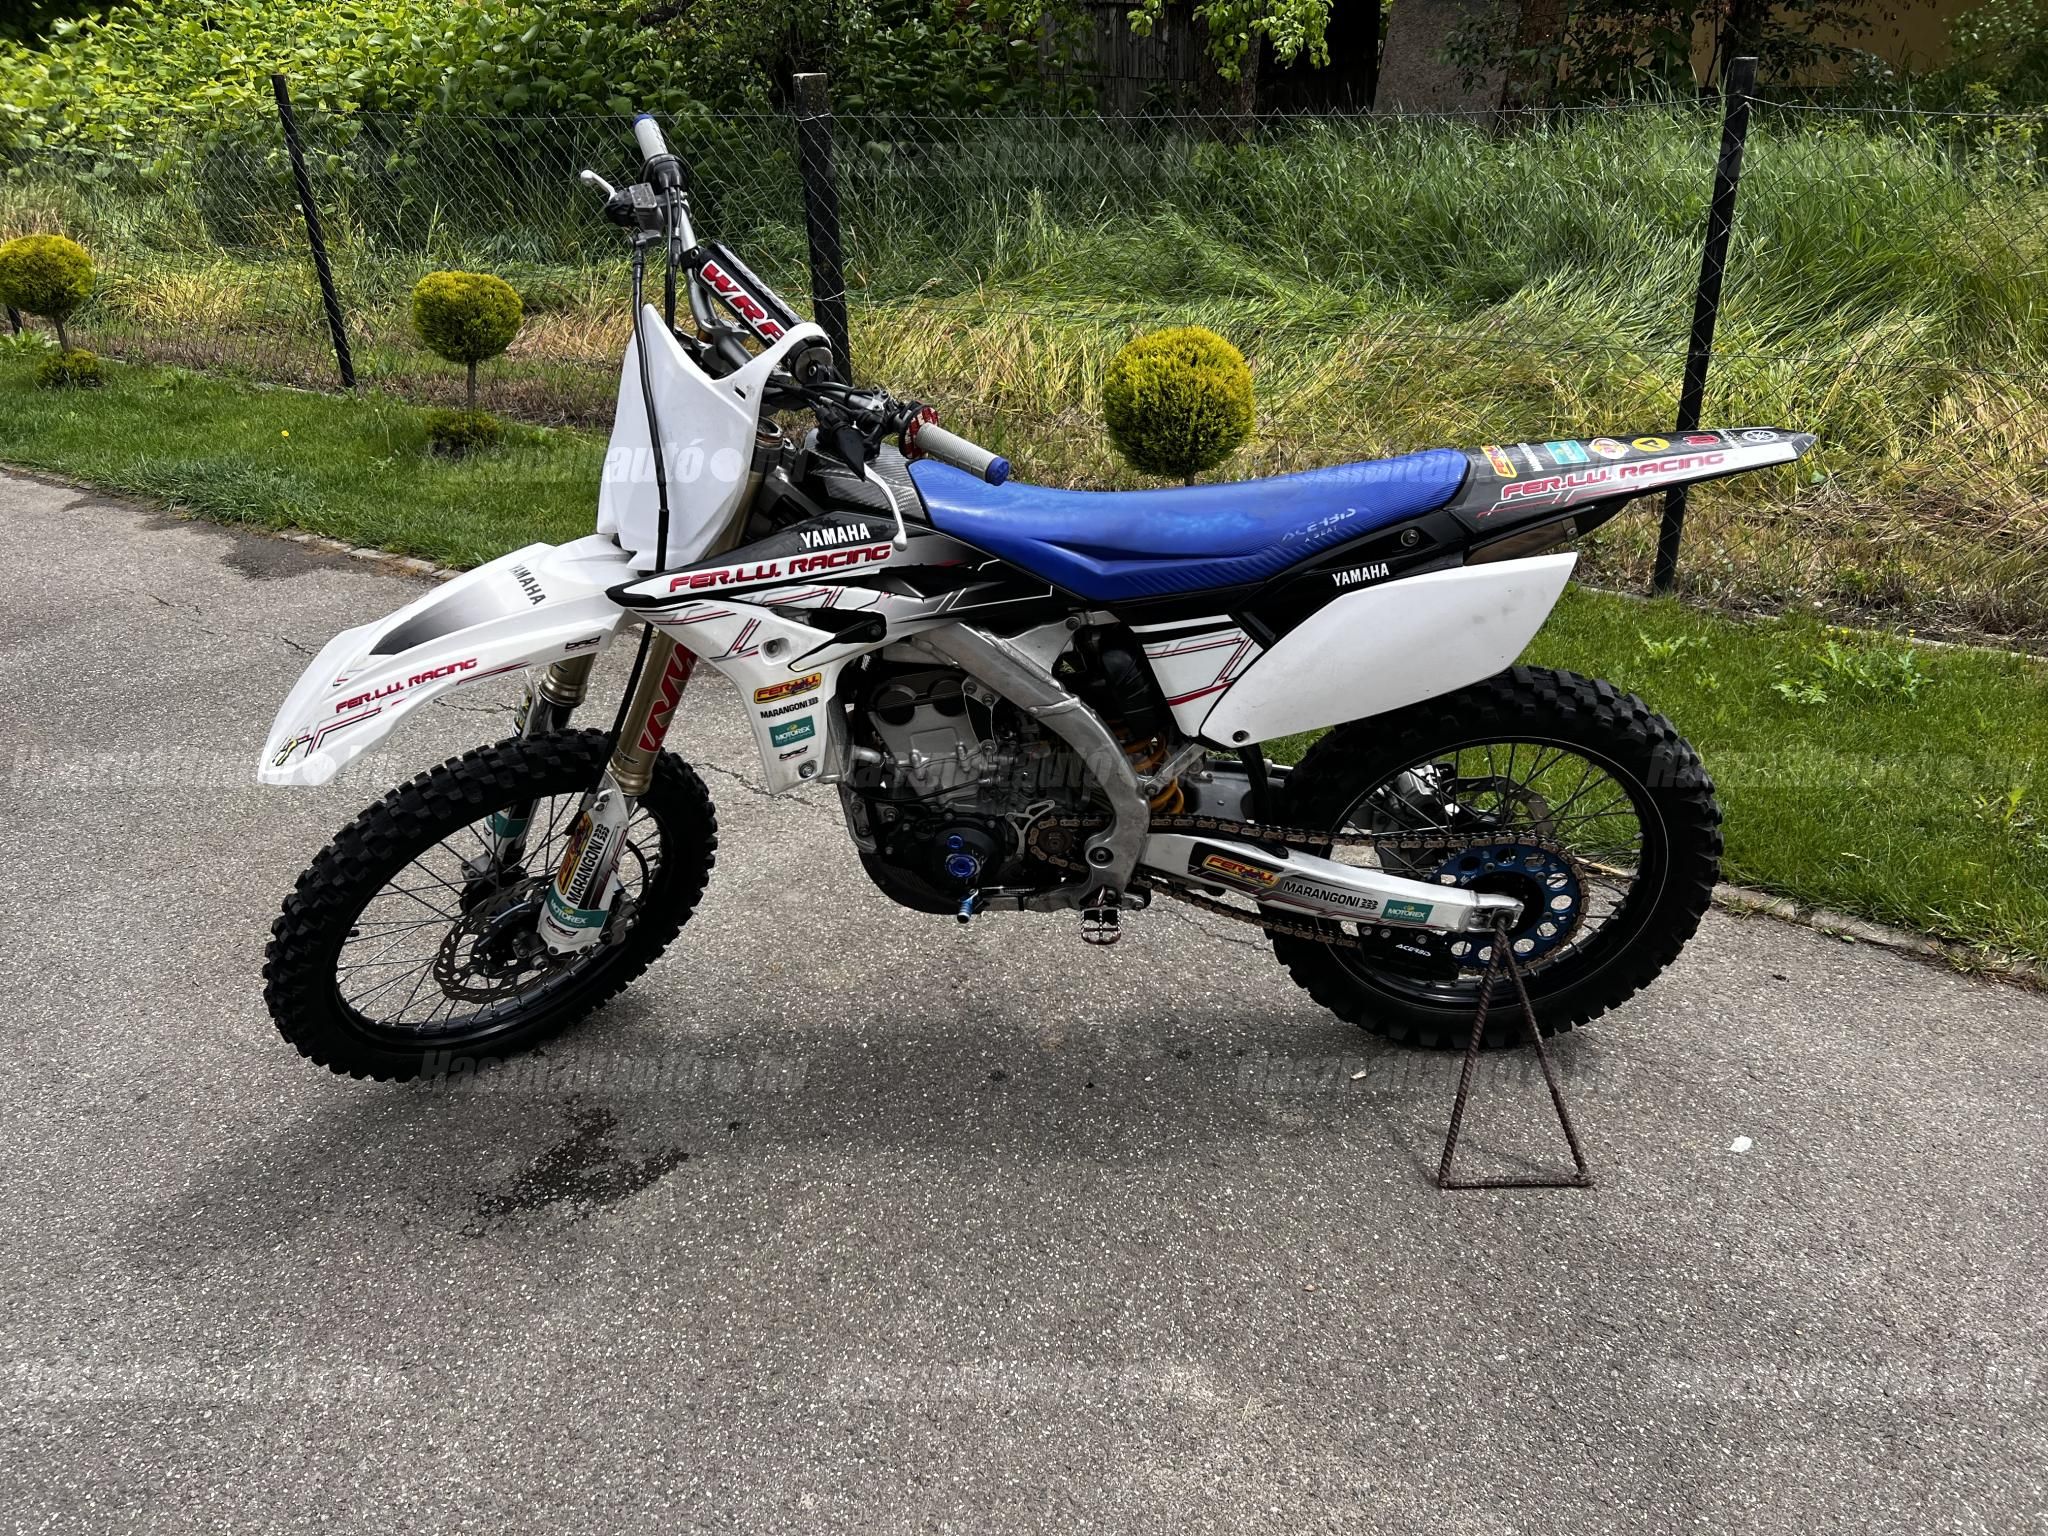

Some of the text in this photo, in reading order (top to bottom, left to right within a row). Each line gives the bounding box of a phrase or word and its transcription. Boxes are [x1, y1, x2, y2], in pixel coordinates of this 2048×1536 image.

[1502, 453, 1725, 499] FER.LU. RACING
[800, 523, 871, 549] YAMAHA
[669, 544, 891, 593] FER.LU. RACING
[1332, 563, 1390, 587] YAMAHA
[508, 564, 546, 606] YAMAHA
[336, 658, 478, 714] FER.LU. RACING
[760, 700, 808, 719] MARANGONI
[775, 725, 811, 740] MOTOREX
[566, 839, 604, 905] MARANGONI
[1283, 881, 1361, 907] MARANGONI
[550, 899, 588, 924] MOTOREX
[1387, 908, 1426, 918] MOTOREX
